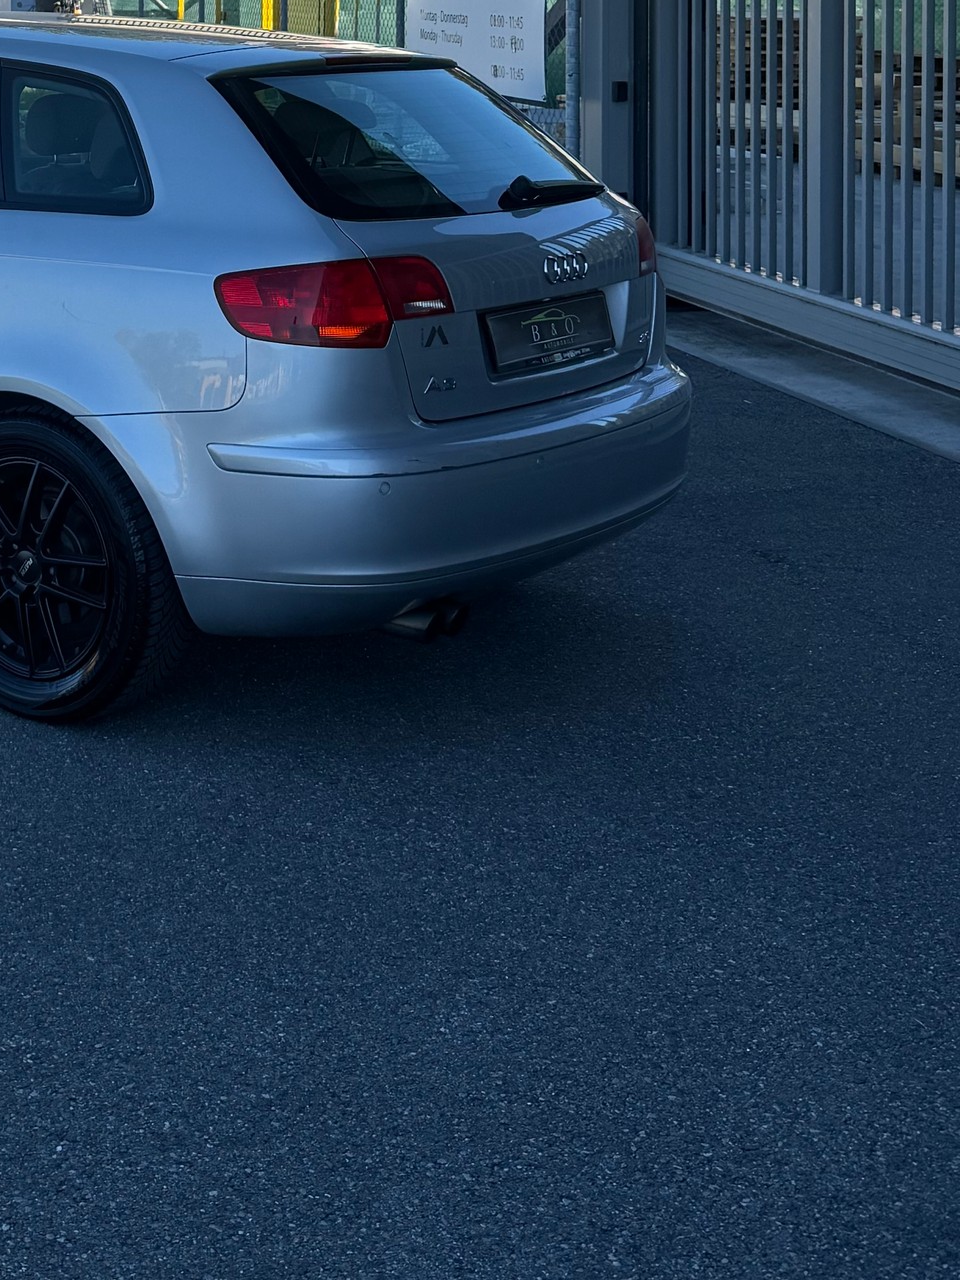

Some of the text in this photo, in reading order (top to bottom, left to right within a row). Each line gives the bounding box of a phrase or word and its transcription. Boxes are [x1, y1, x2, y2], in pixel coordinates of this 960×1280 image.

[440, 10, 468, 28] Donnerstag
[509, 15, 523, 30] 11:45
[420, 28, 438, 45] Monday
[441, 29, 463, 47] Thursday
[490, 35, 505, 49] 13:00
[510, 66, 525, 81] 11:45
[531, 317, 574, 342] B & O
